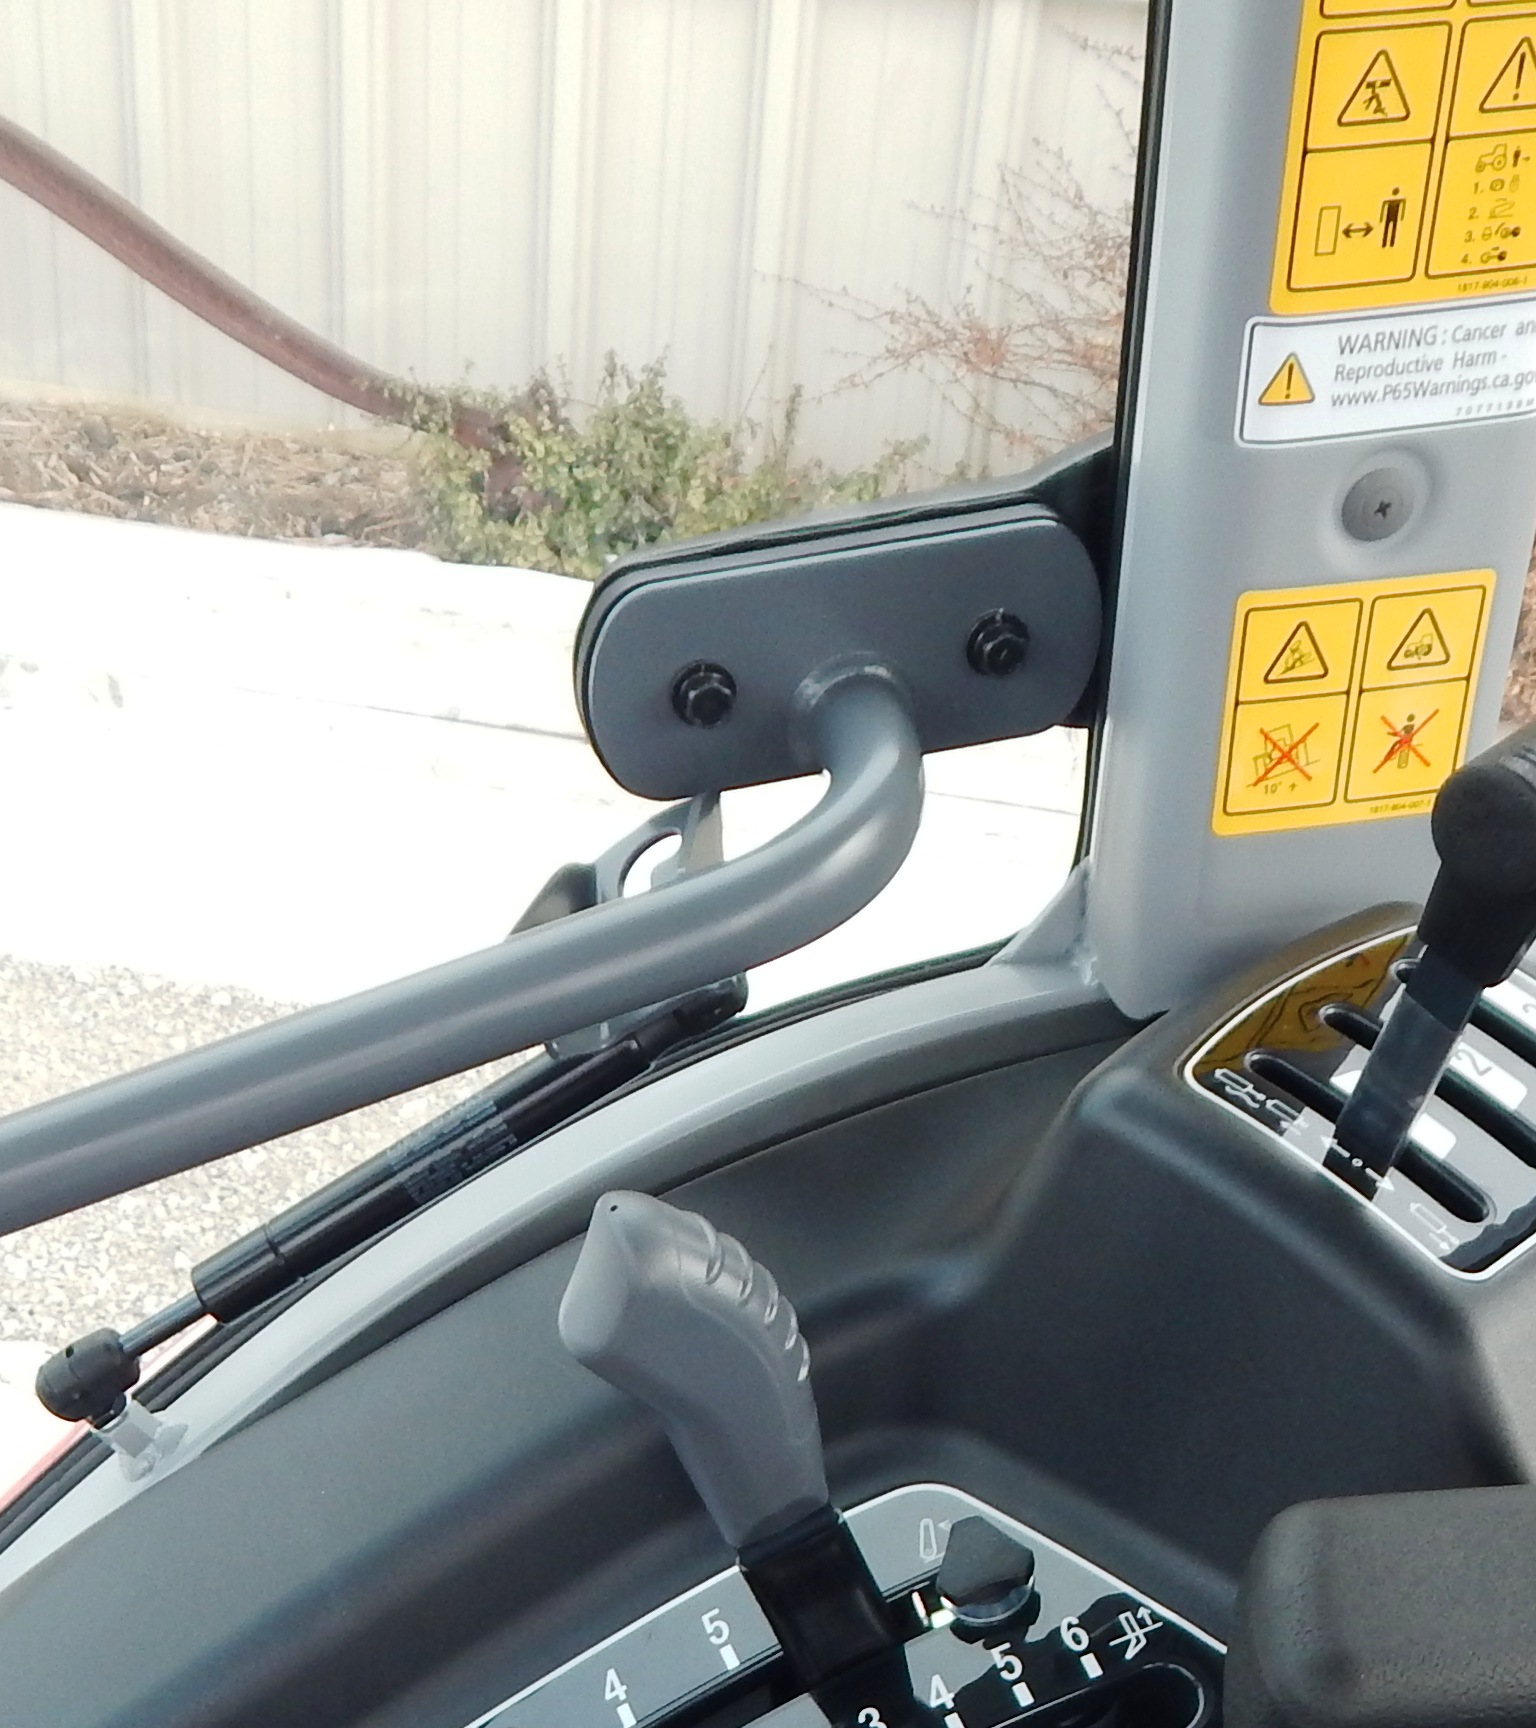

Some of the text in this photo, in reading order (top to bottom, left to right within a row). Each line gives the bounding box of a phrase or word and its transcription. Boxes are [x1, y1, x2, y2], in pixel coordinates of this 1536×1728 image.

[1451, 324, 1508, 344] Cancer
[1334, 354, 1444, 384] Reproductive
[1453, 350, 1498, 370] Harm
[1455, 1049, 1494, 1078] 2
[602, 1668, 627, 1706] 4
[698, 1609, 730, 1645] 5
[927, 1676, 955, 1711] 4
[994, 1645, 1023, 1680] 5
[1061, 1616, 1089, 1651] 6
